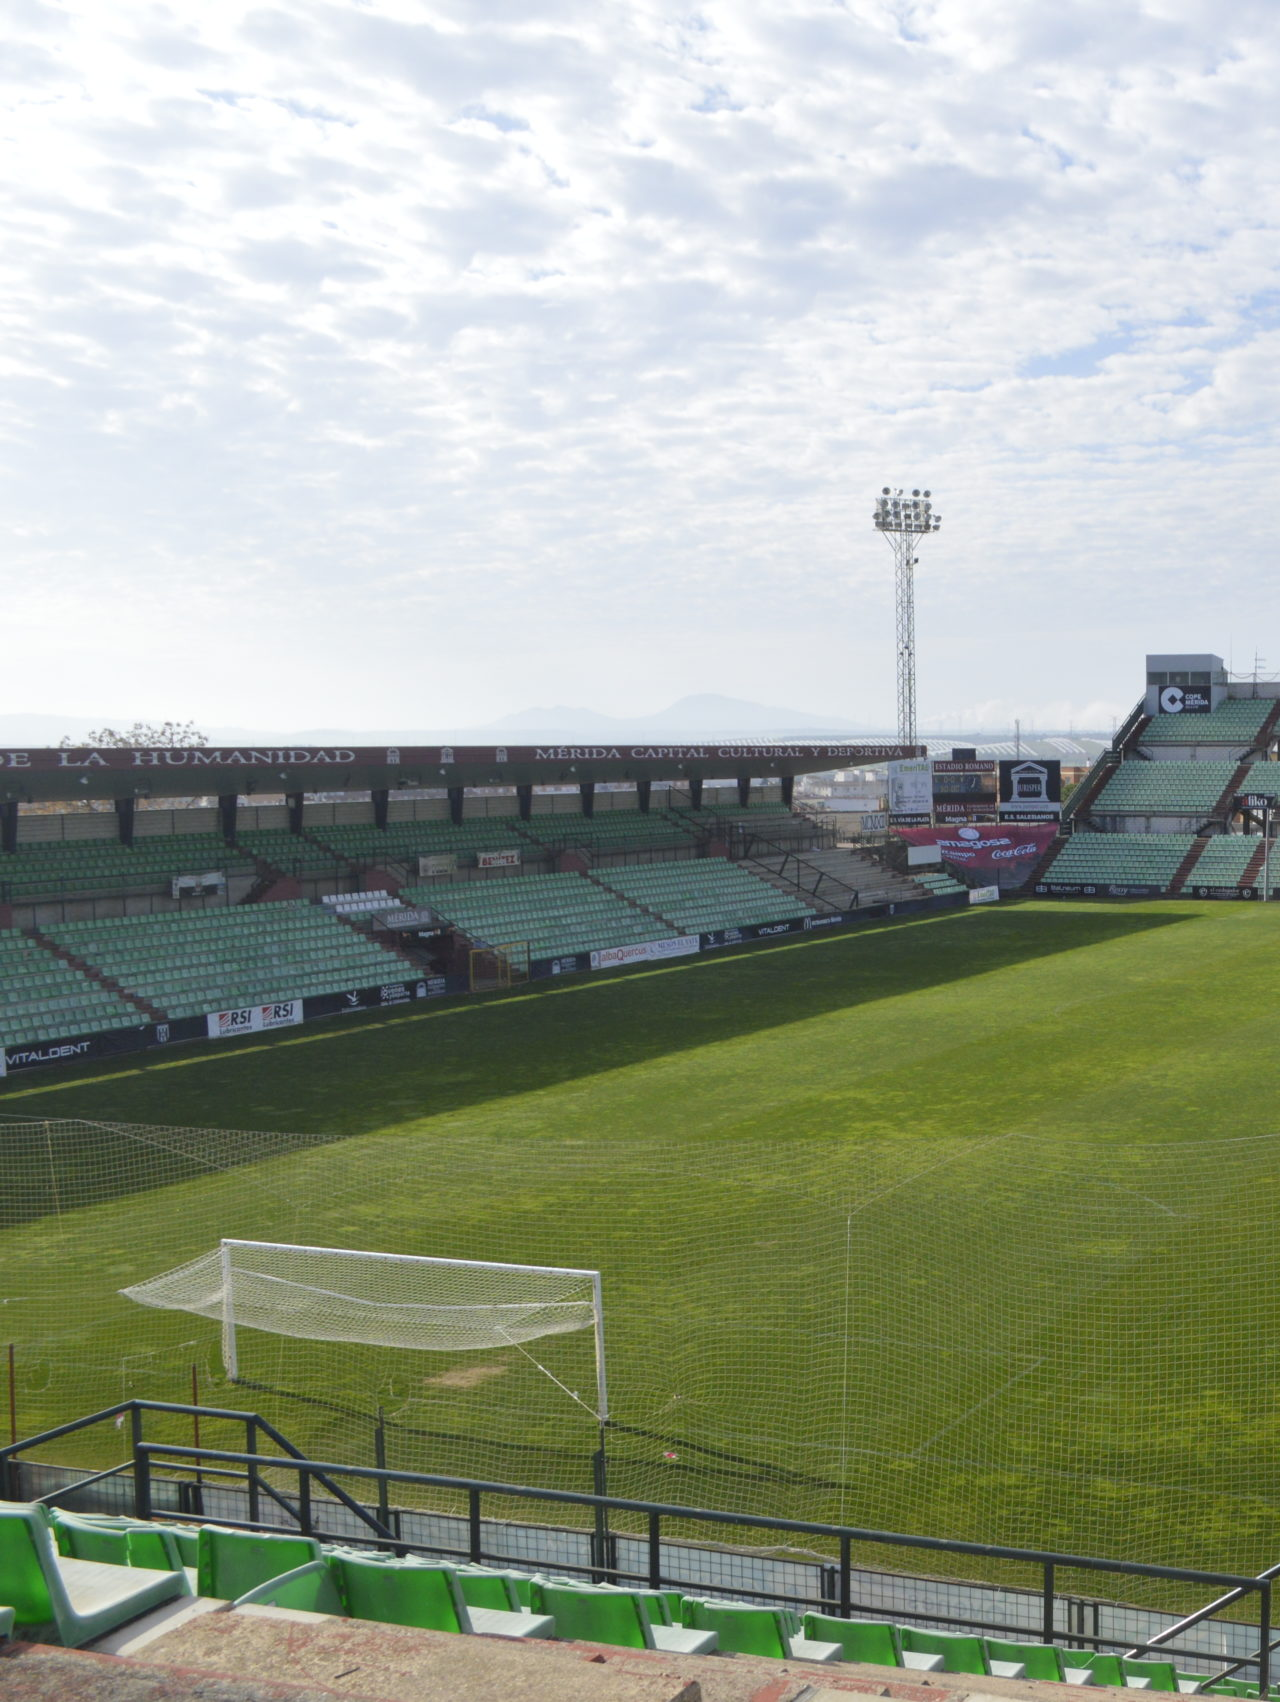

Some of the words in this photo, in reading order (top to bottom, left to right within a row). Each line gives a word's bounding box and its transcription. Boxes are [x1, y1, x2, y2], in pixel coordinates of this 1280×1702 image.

[0, 752, 31, 767] E
[58, 751, 110, 767] LA
[132, 750, 356, 766] HUMANIDAD
[534, 745, 622, 760] MÉRIDA
[631, 747, 709, 759] CAPITAL
[718, 747, 803, 758] CULTURAL
[810, 748, 822, 758] Y
[827, 747, 904, 757] DEPORTIVA
[935, 762, 964, 770] ESTADIO
[965, 762, 994, 770] ROMANO
[936, 803, 965, 812] MÉRIDA
[936, 838, 1012, 850] amagosa
[758, 923, 790, 935] VITALDENT
[231, 1010, 252, 1025] RSI
[273, 1003, 294, 1018] RSI
[5, 1042, 90, 1065] VITALDENT
